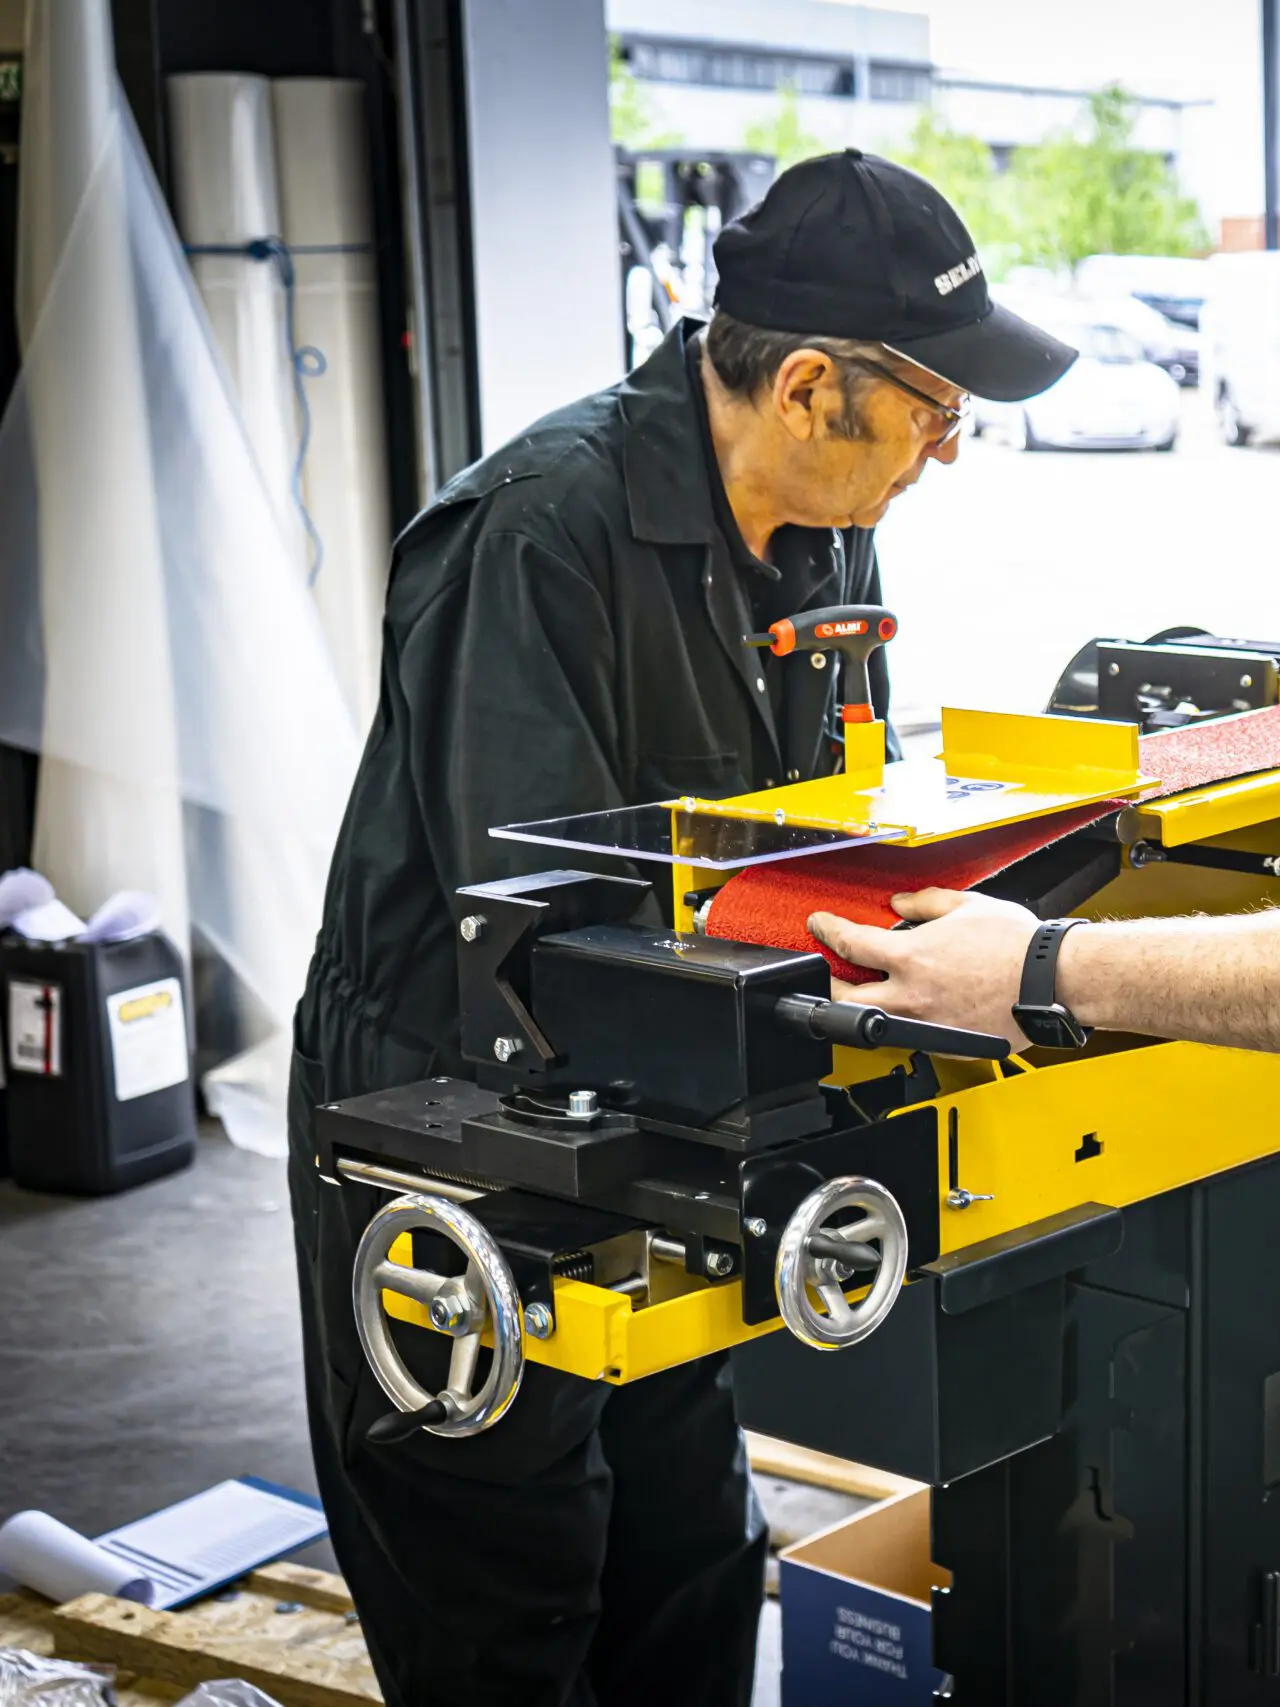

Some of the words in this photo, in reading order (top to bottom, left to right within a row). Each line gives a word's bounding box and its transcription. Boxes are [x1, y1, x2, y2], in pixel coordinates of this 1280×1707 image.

[835, 621, 862, 633] ALMI
[836, 1606, 901, 1642] BUSINESS
[834, 1624, 873, 1648] YOUR
[829, 1640, 859, 1661] YOU
[874, 1639, 904, 1660] FOR
[861, 1651, 908, 1679] THANK
